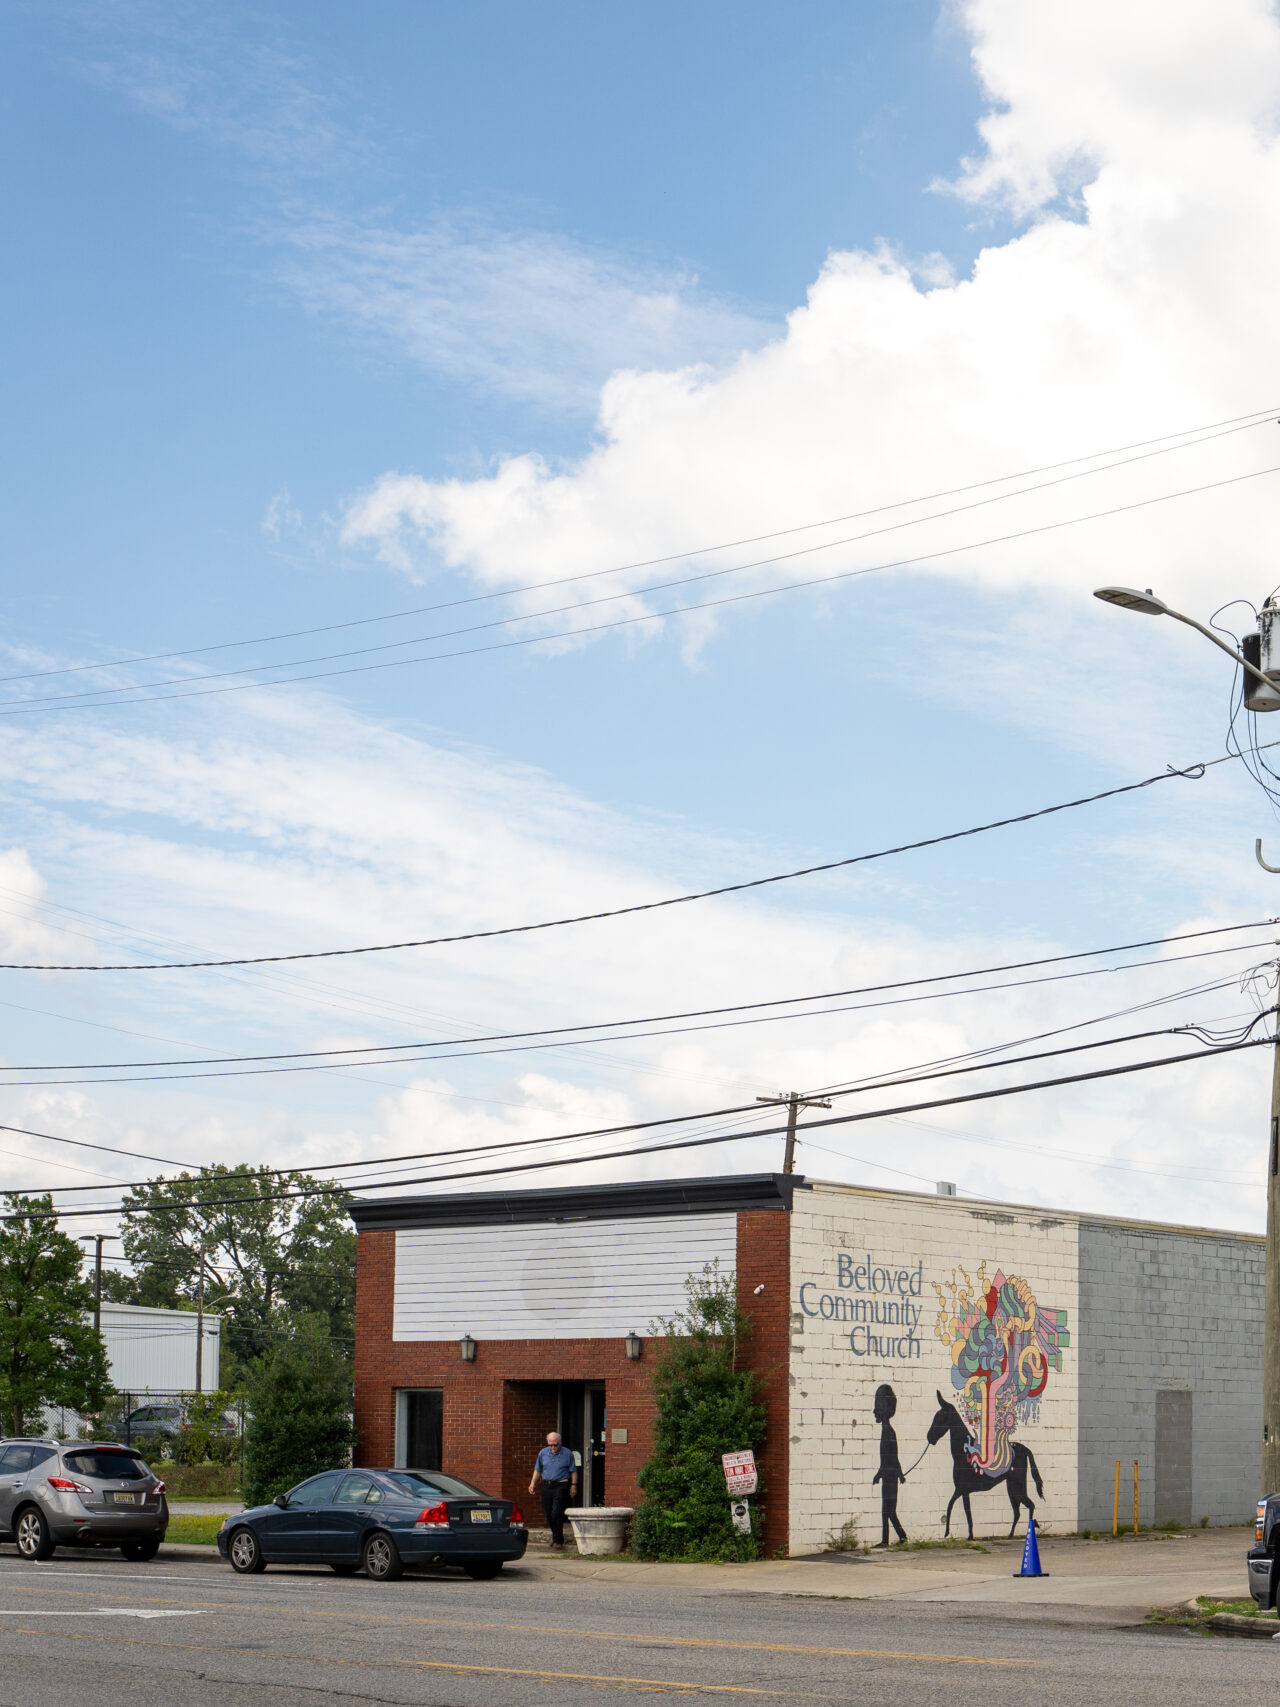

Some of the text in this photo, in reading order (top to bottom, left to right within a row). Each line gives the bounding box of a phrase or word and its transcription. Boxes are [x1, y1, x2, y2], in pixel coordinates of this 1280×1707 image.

[837, 1253, 923, 1296] Beloved
[800, 1282, 923, 1337] Community
[850, 1325, 920, 1359] Church
